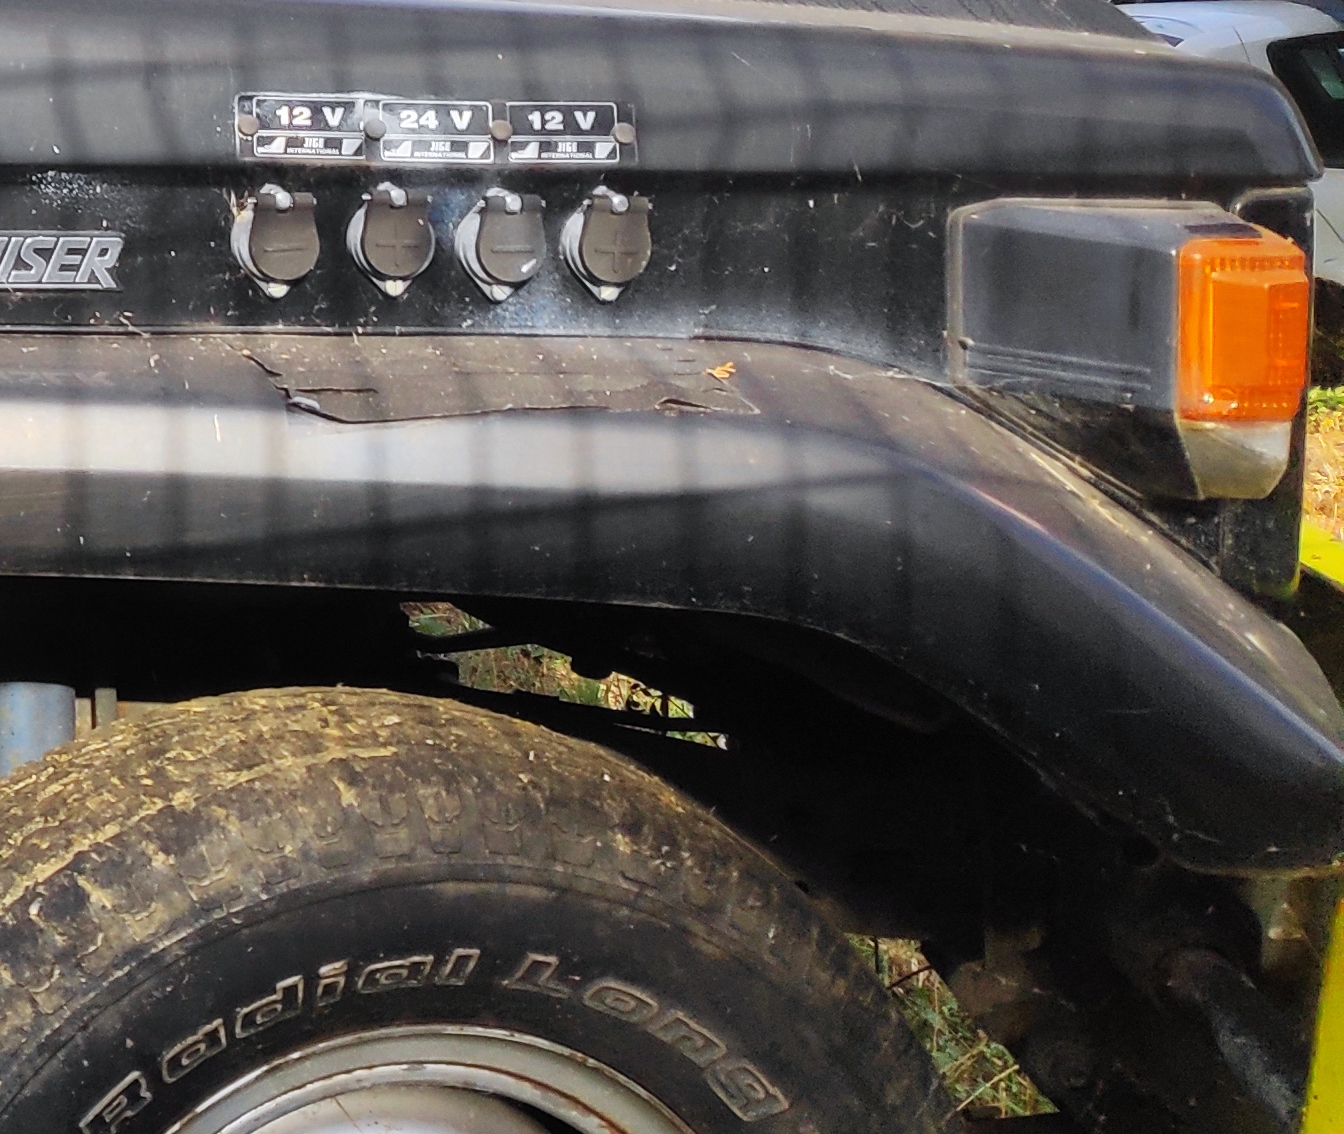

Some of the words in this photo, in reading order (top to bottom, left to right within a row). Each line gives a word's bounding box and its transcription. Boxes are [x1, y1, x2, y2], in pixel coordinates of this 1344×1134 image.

[275, 105, 312, 126] 12
[322, 106, 345, 127] V
[399, 109, 439, 130] 24
[450, 110, 473, 131] V
[527, 111, 564, 130] 12
[573, 111, 596, 131] V
[286, 147, 340, 155] INTERNATIONAL
[78, 948, 481, 1134] Radial
